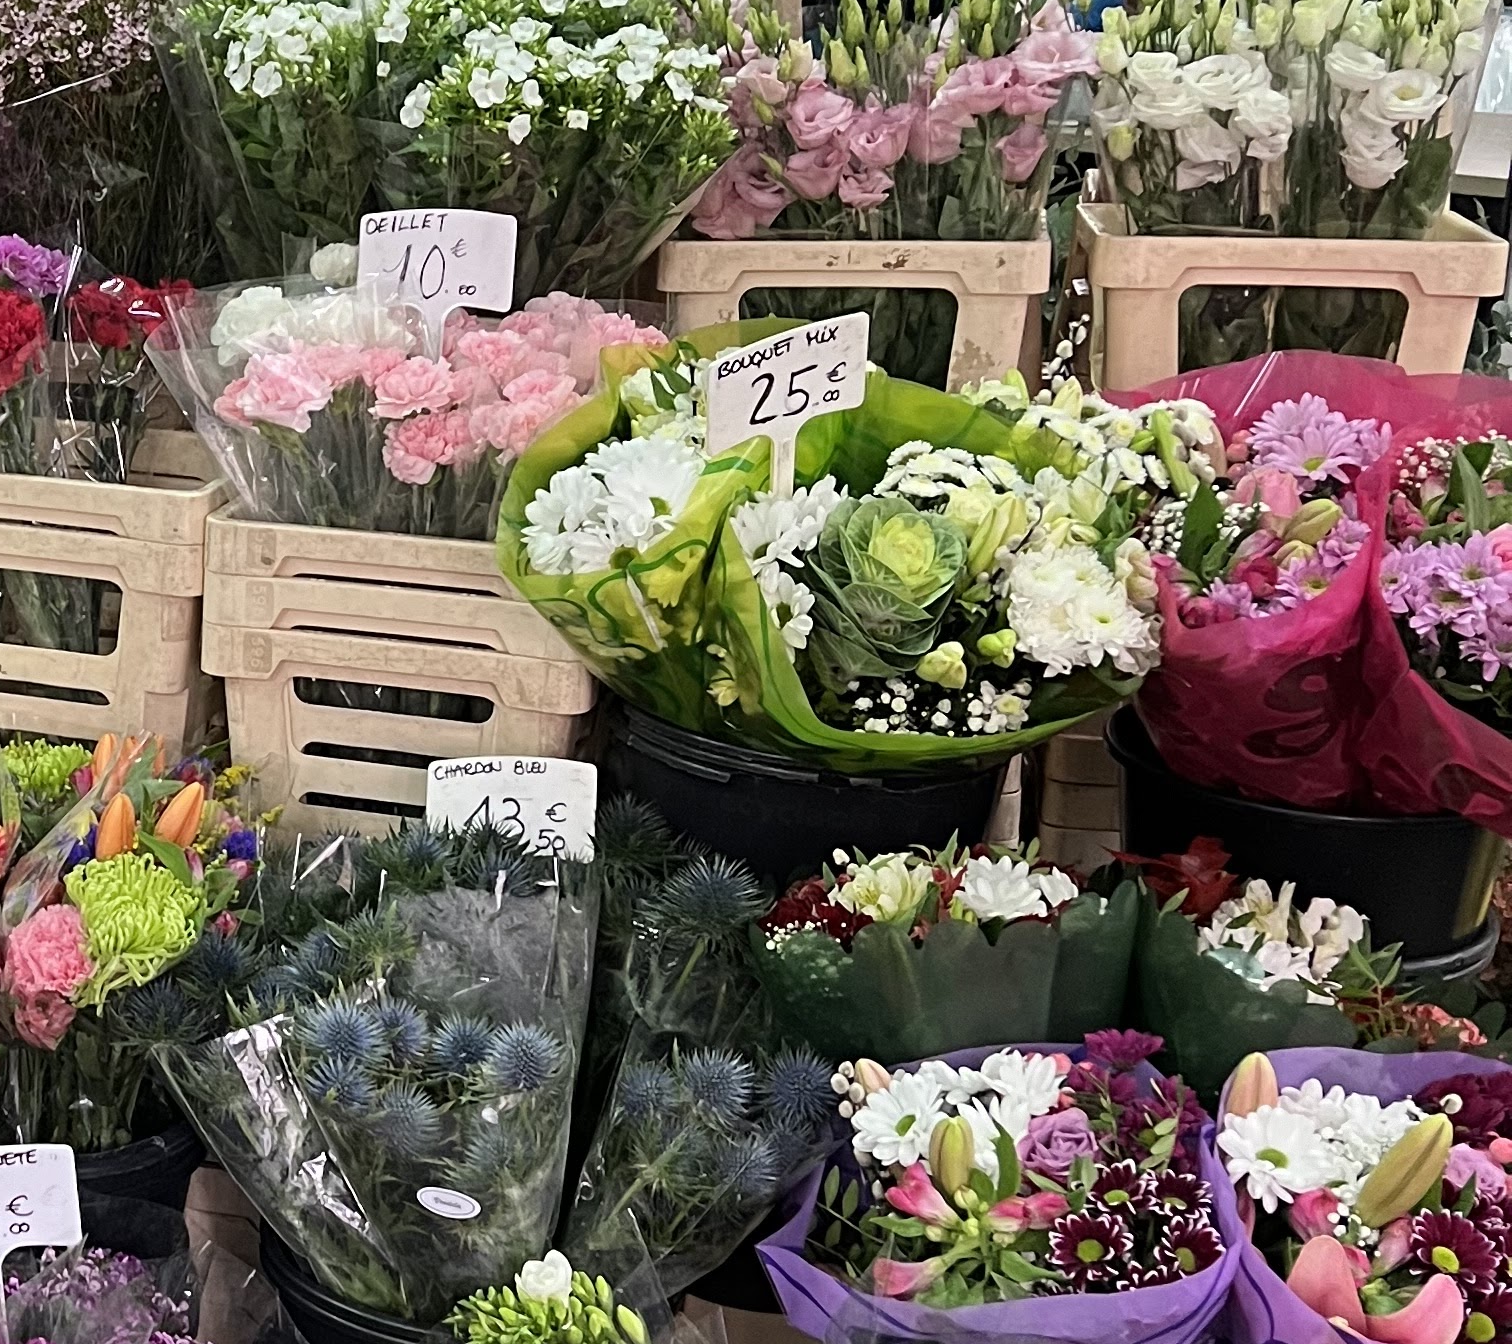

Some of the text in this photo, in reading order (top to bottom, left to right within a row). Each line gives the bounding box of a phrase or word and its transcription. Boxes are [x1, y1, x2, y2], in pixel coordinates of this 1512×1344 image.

[366, 213, 448, 235] OEILLET
[383, 244, 445, 299] 10
[450, 238, 467, 258] €
[718, 336, 794, 380] BOUQUET
[749, 364, 818, 425] 25
[826, 361, 846, 382] €
[434, 760, 546, 780] CHARDON BLEU
[545, 802, 567, 822] €
[5, 1195, 33, 1216] €
